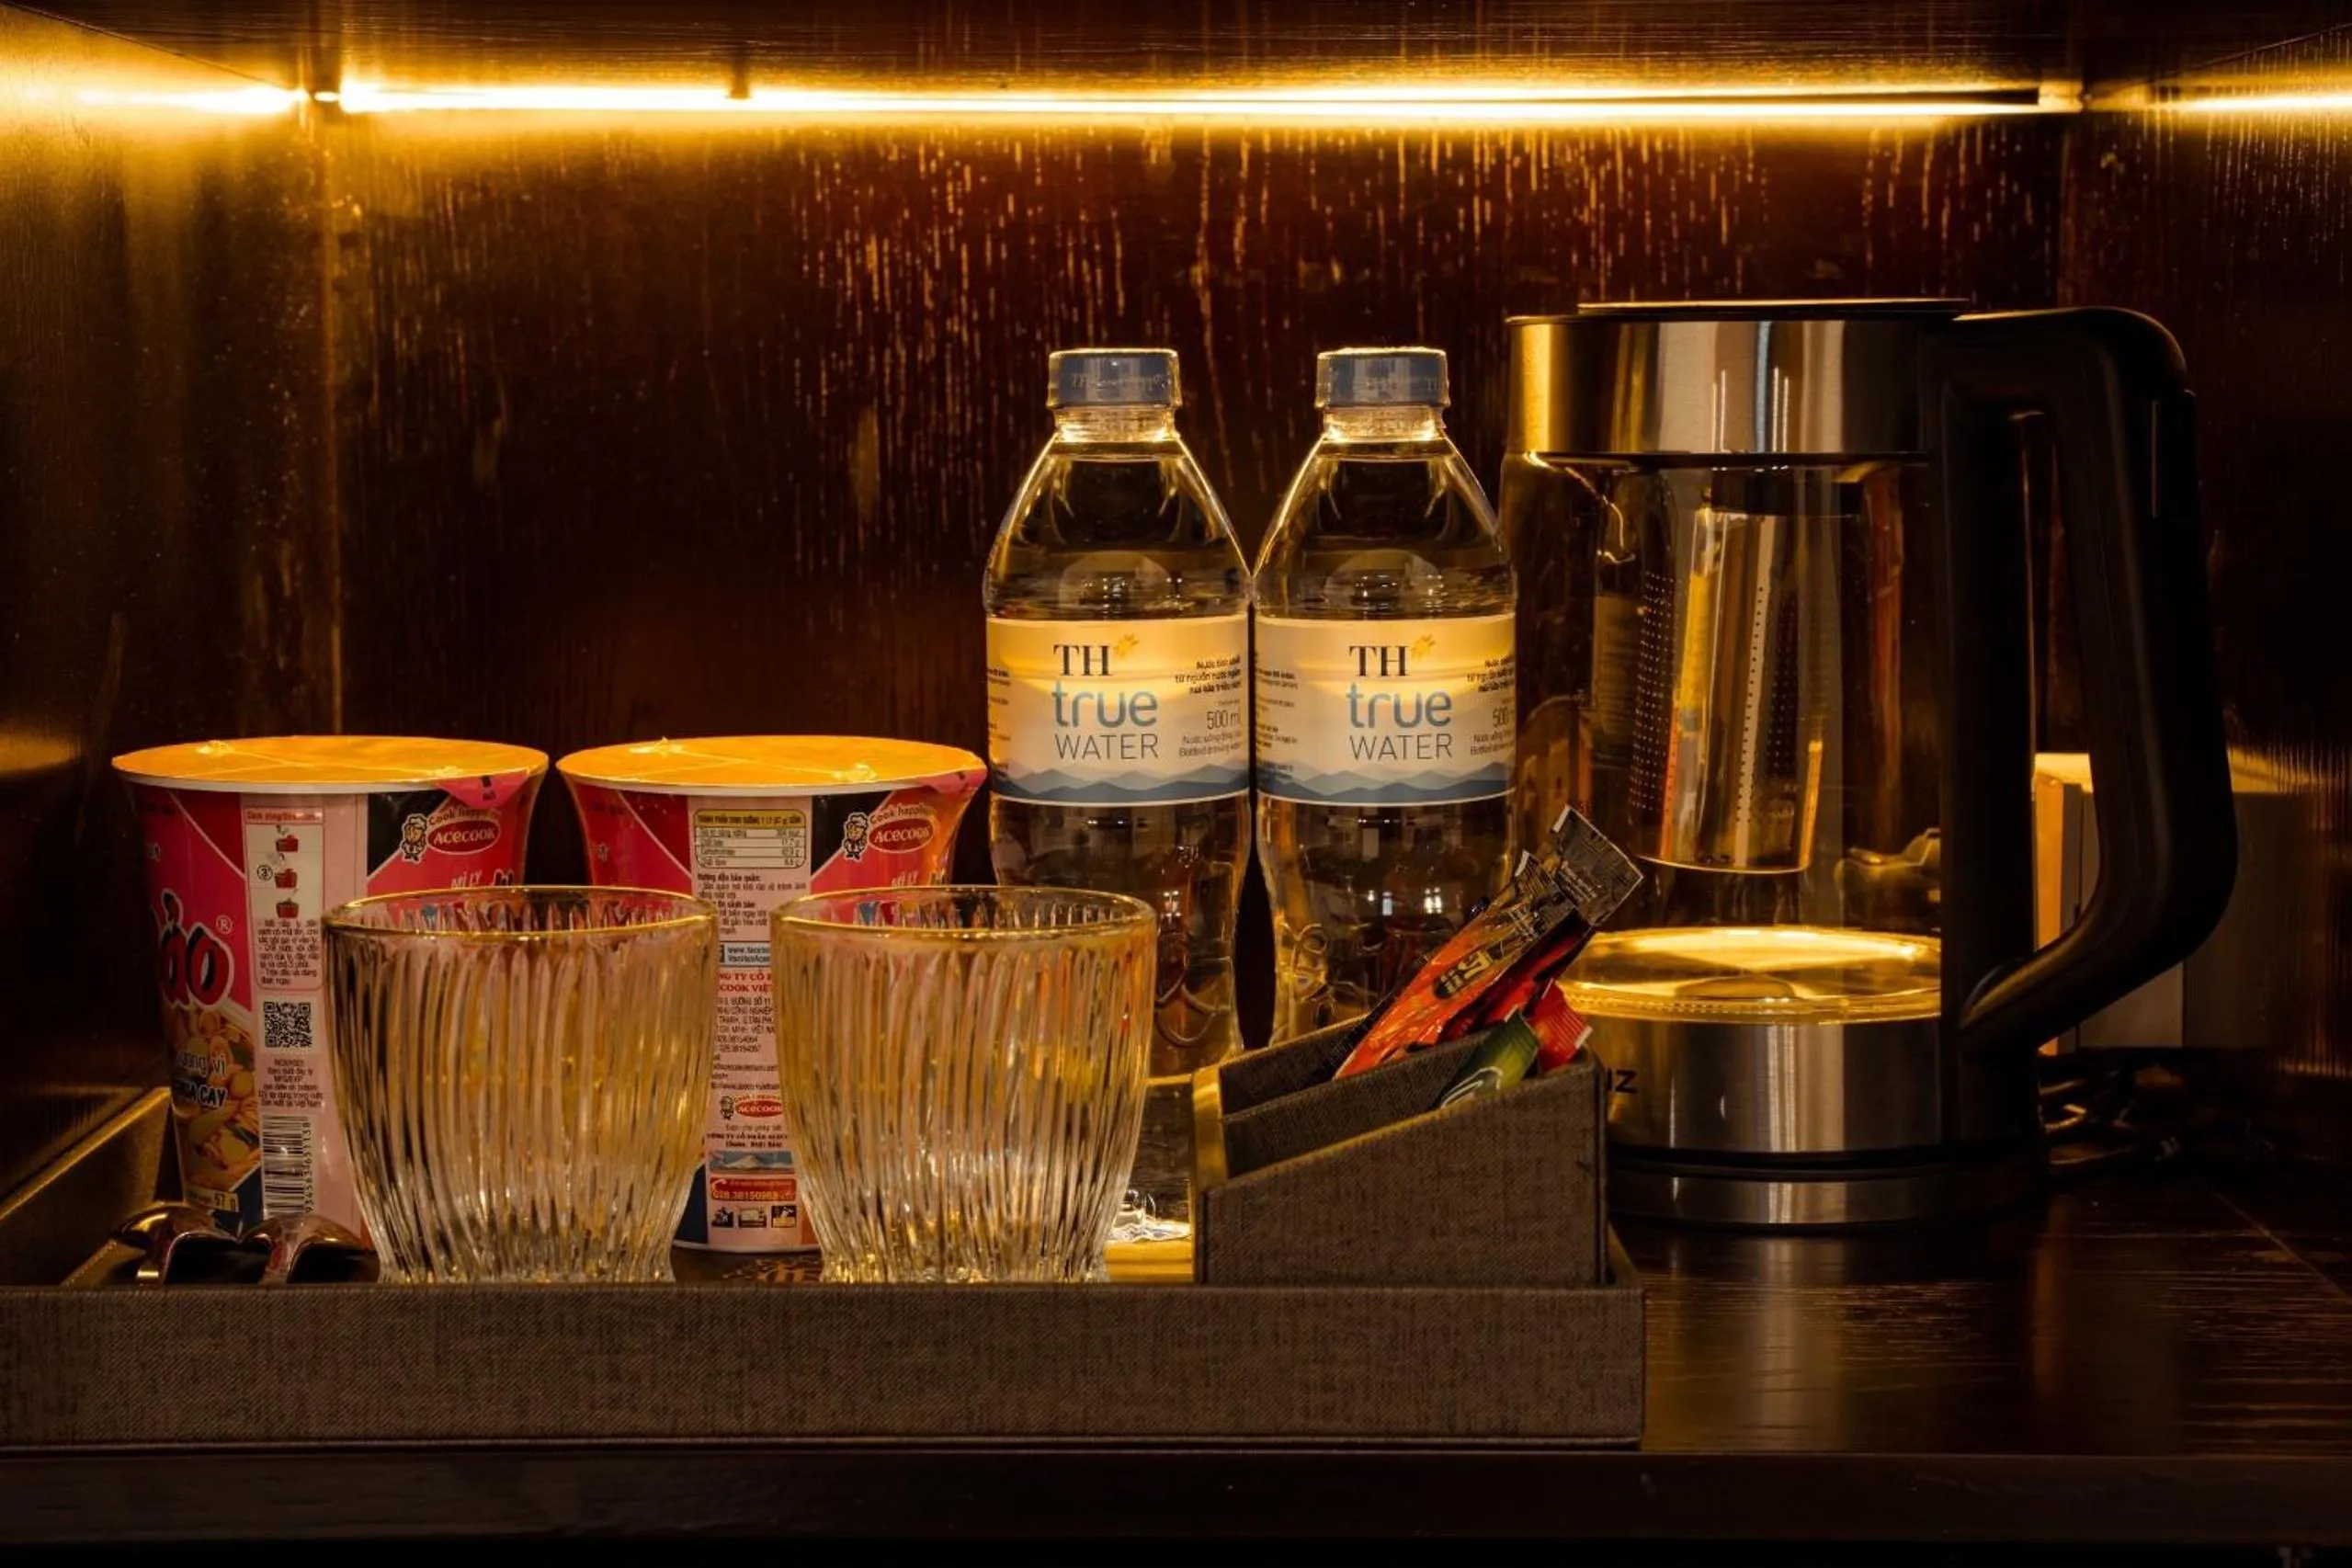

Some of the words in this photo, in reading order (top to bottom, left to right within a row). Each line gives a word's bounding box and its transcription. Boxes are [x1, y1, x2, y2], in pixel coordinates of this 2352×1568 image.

[1053, 645, 1113, 676] TH
[1349, 645, 1410, 676] TH
[1051, 681, 1158, 728] true
[1346, 682, 1452, 728] true
[1207, 709, 1228, 730] 500
[1493, 706, 1508, 728] 500
[1054, 734, 1159, 759] WATER
[1349, 733, 1452, 760] WATER
[428, 807, 456, 825] Cook
[735, 972, 747, 981] TY
[752, 983, 769, 993] VIỆ
[199, 1085, 228, 1108] CAY
